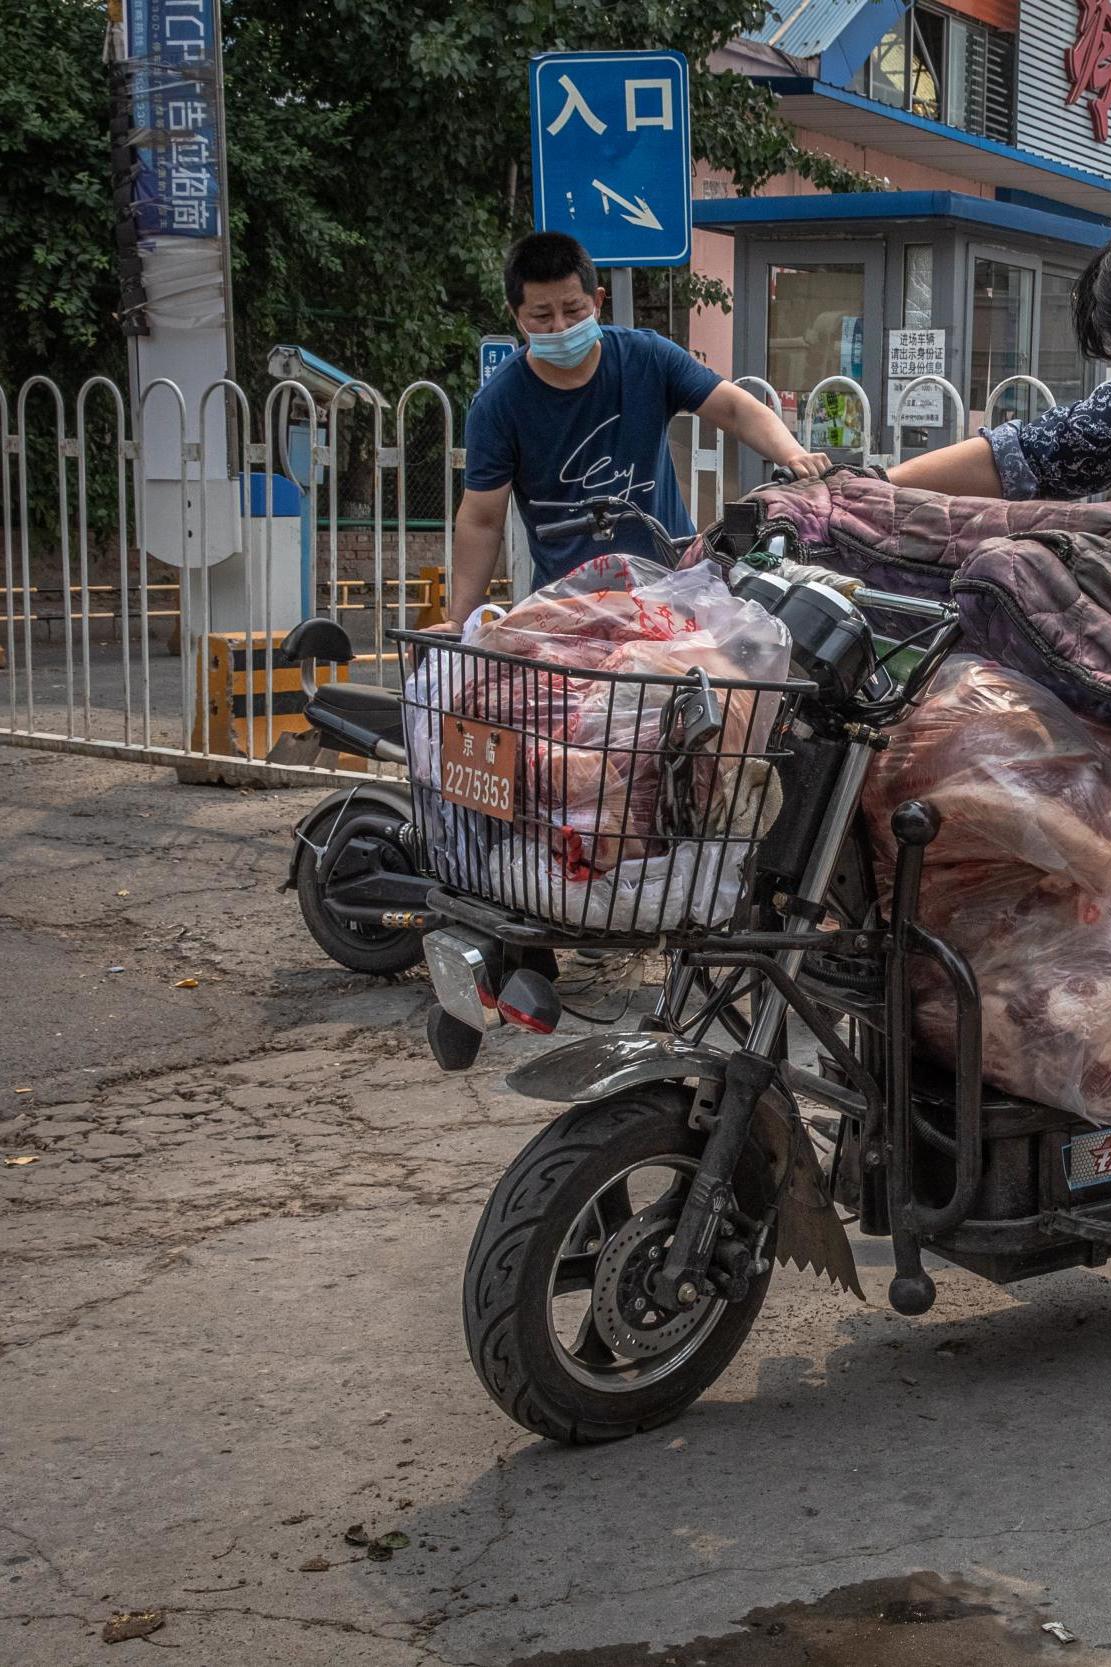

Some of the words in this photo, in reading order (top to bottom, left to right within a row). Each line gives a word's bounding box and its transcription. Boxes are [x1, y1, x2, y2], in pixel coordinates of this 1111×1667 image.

[546, 74, 674, 136] 入口
[900, 333, 935, 346] 进场车辆
[891, 347, 944, 361] 请出示身份证
[891, 361, 943, 375] 登记身份信息
[446, 761, 510, 810] 2275353
